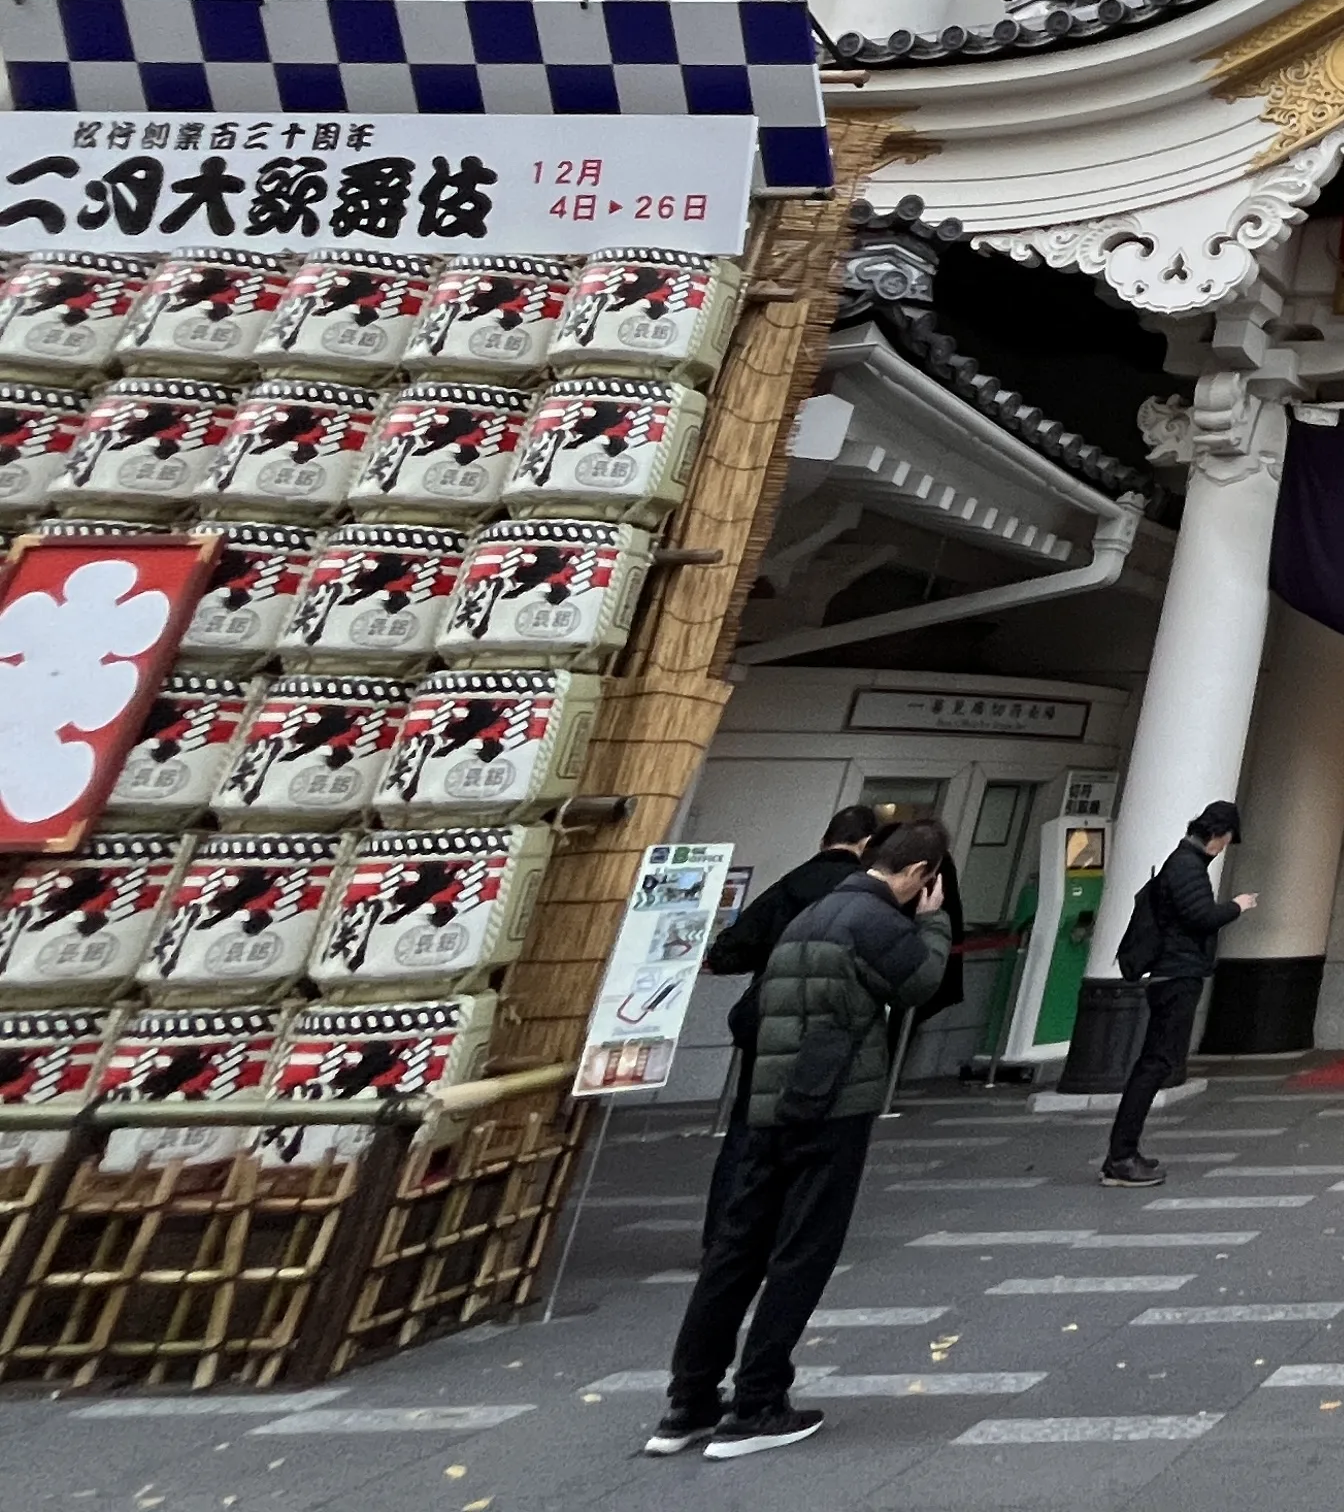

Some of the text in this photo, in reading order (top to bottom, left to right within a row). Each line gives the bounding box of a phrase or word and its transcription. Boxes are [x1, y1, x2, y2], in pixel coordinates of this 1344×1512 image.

[73, 121, 377, 152] 松竹創業百三十周年
[532, 158, 603, 186] 12月
